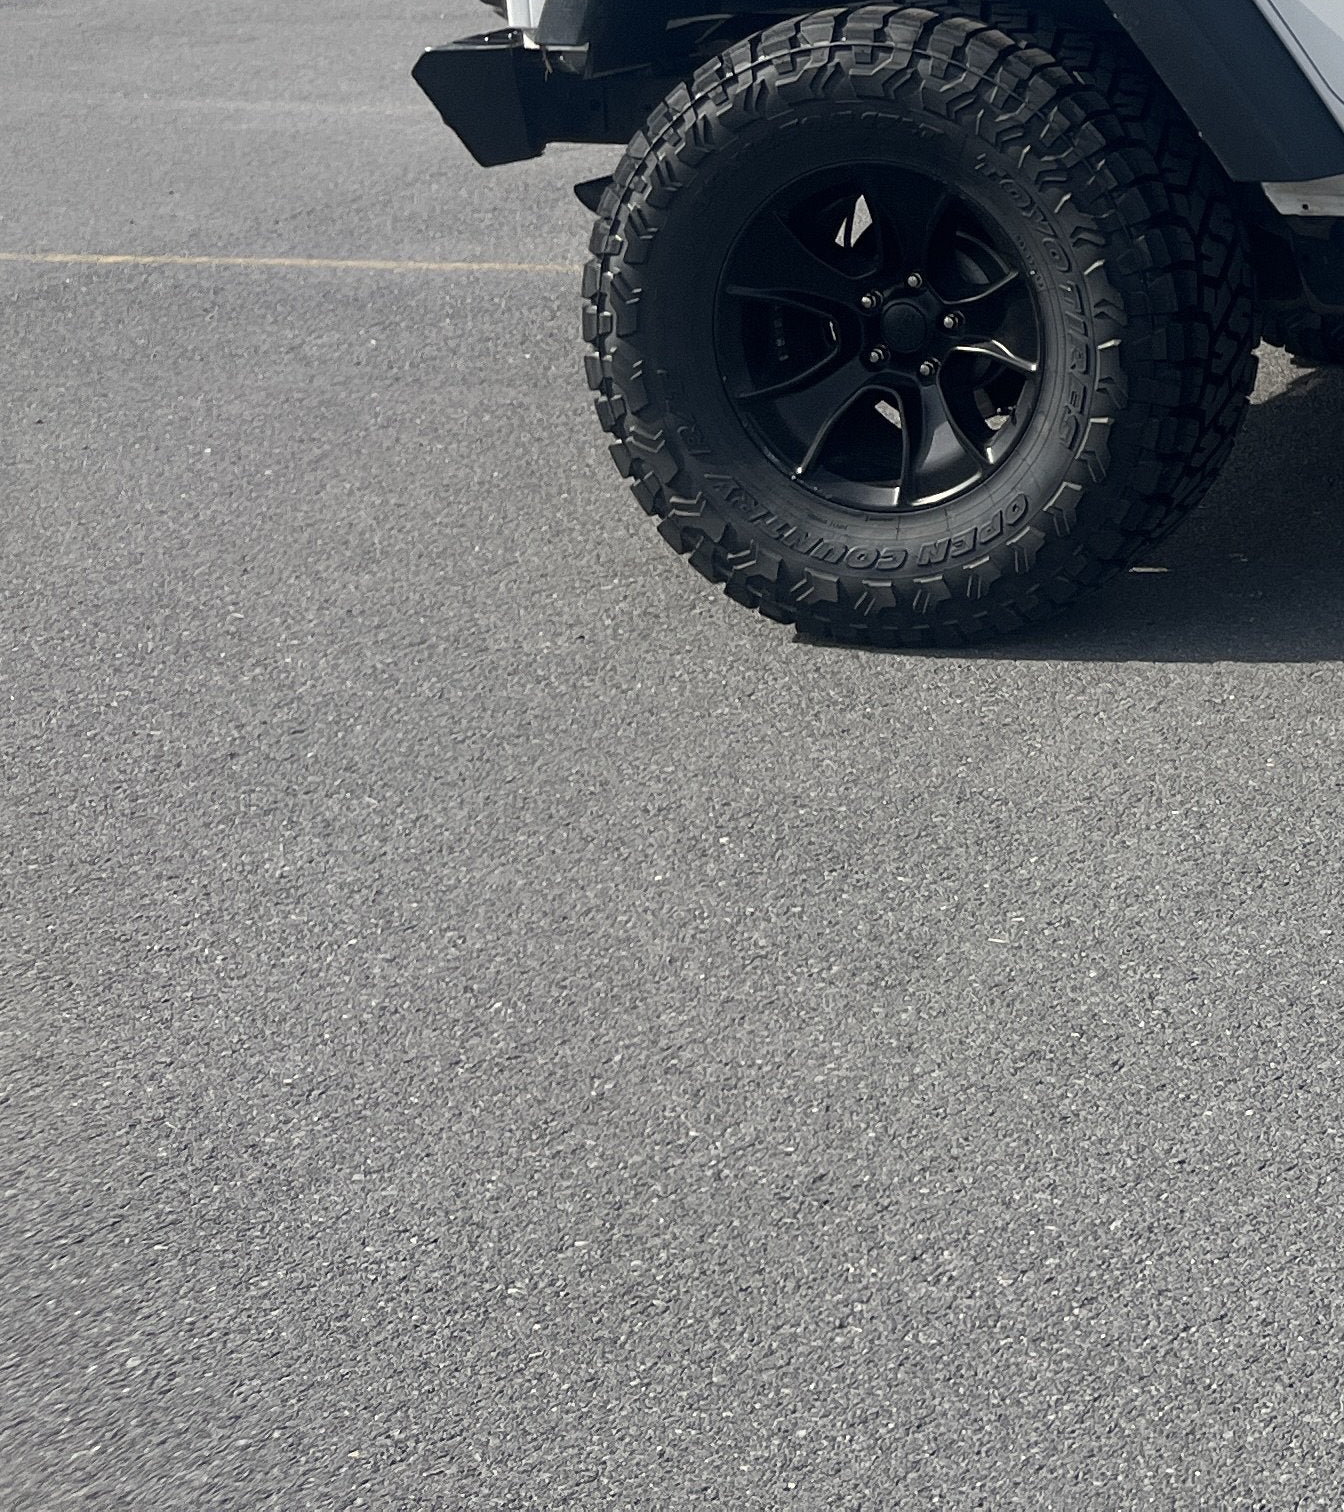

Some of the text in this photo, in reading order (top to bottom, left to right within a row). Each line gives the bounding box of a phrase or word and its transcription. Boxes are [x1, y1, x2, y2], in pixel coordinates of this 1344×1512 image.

[974, 152, 1072, 274] TOYO
[1059, 280, 1088, 451] TIRES
[703, 473, 1029, 570] OPEN COUNTRY
